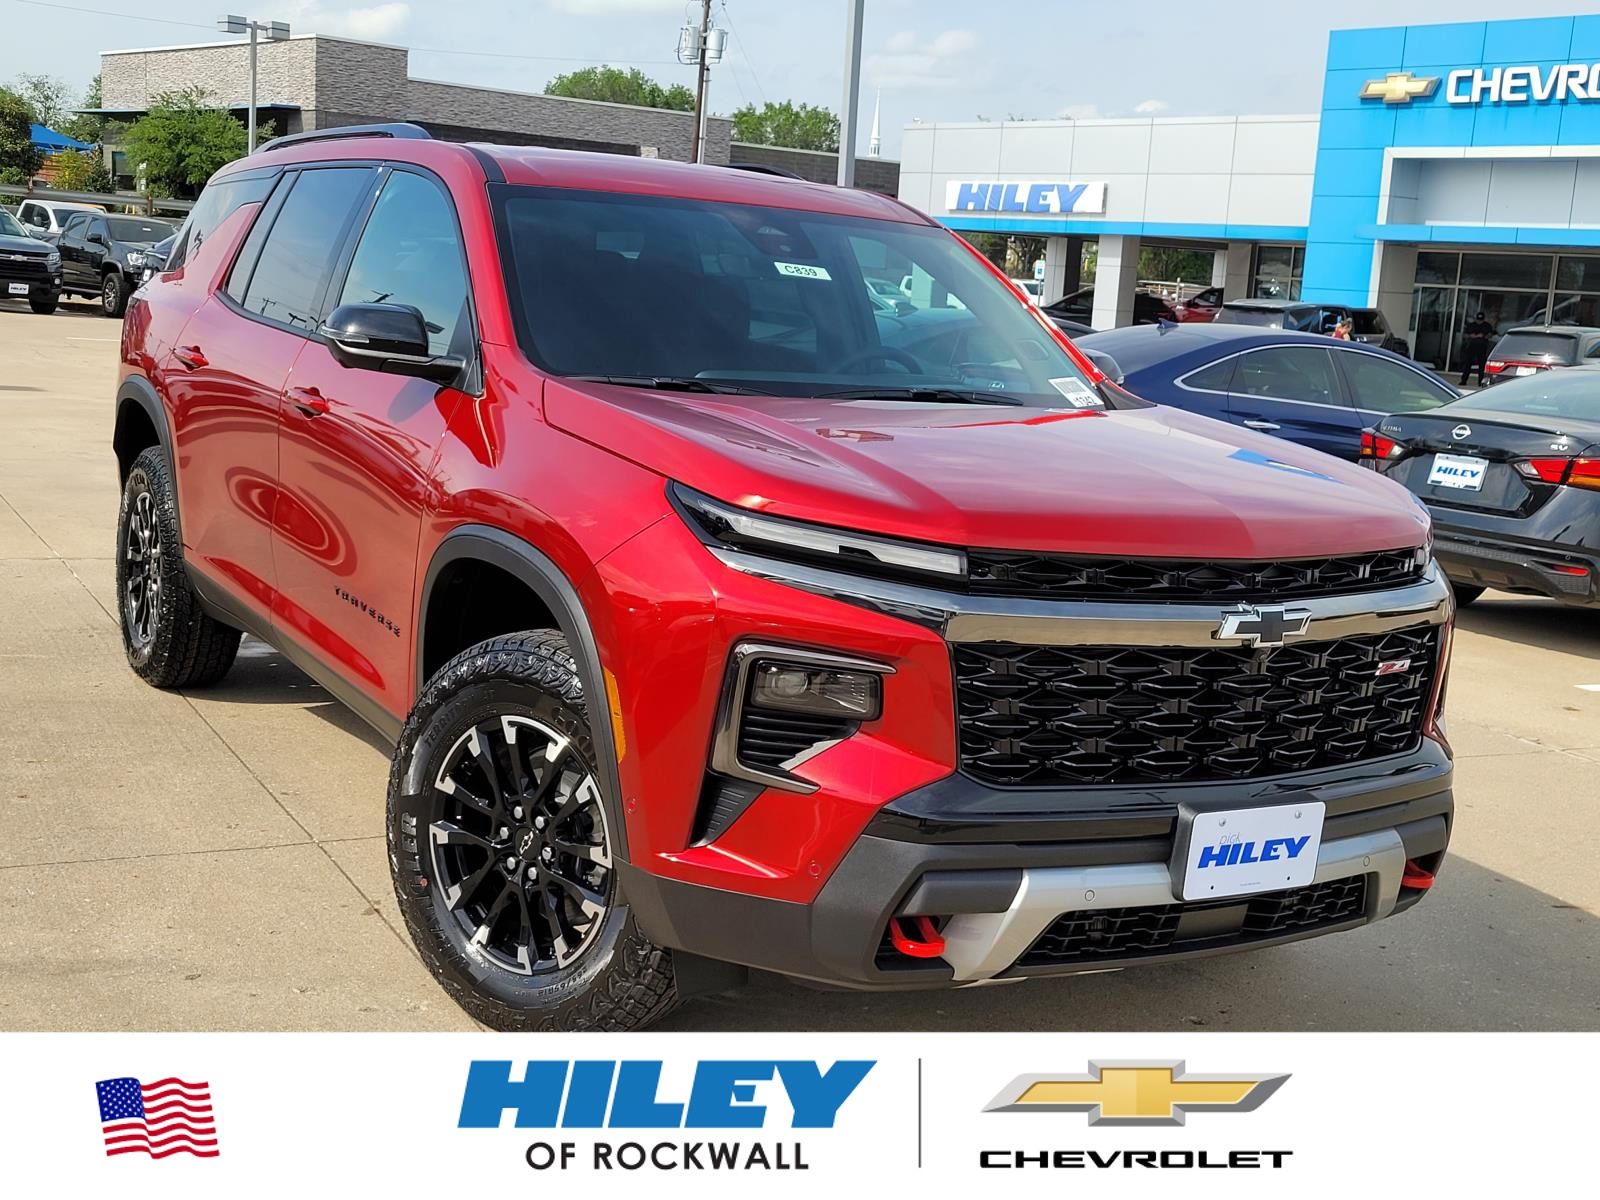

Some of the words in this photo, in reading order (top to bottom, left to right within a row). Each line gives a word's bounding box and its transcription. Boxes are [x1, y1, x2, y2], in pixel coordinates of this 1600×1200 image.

[956, 183, 1089, 213] HILEY
[784, 265, 818, 277] C839
[1436, 466, 1480, 478] HILEY
[1197, 835, 1312, 869] HILEY
